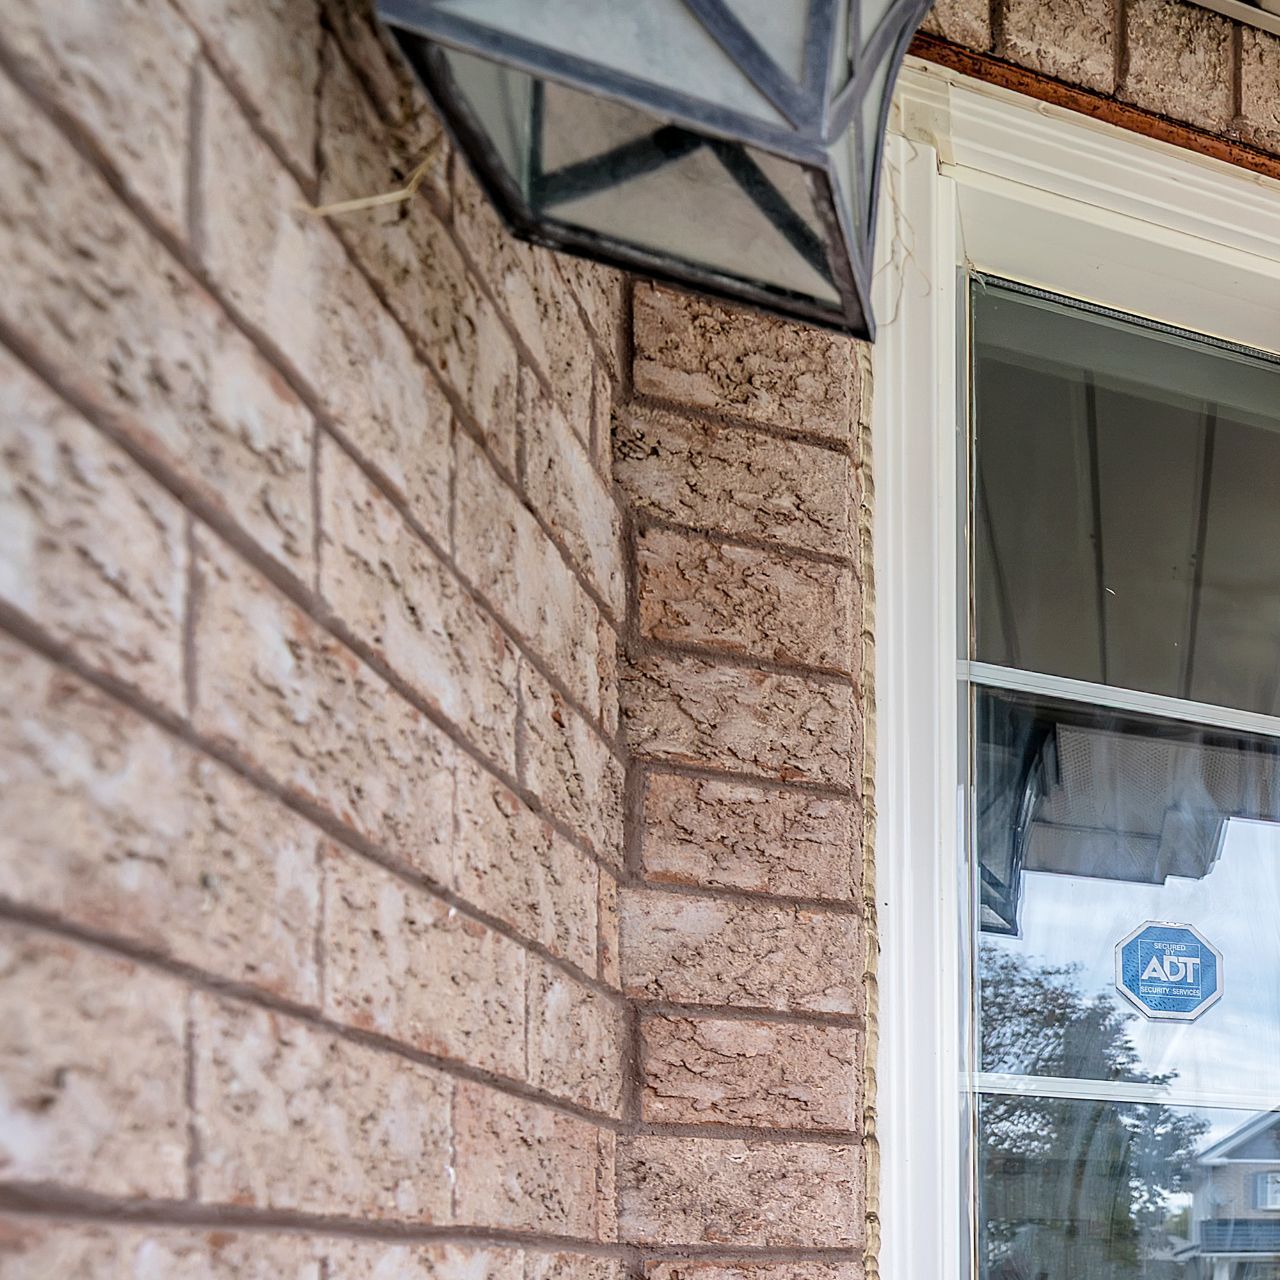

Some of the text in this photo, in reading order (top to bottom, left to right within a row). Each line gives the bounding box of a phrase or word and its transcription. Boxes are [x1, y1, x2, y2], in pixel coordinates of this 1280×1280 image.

[1153, 942, 1186, 951] SECURED
[1141, 955, 1200, 983] ADT
[1141, 986, 1201, 997] SECURITY SERVICES
